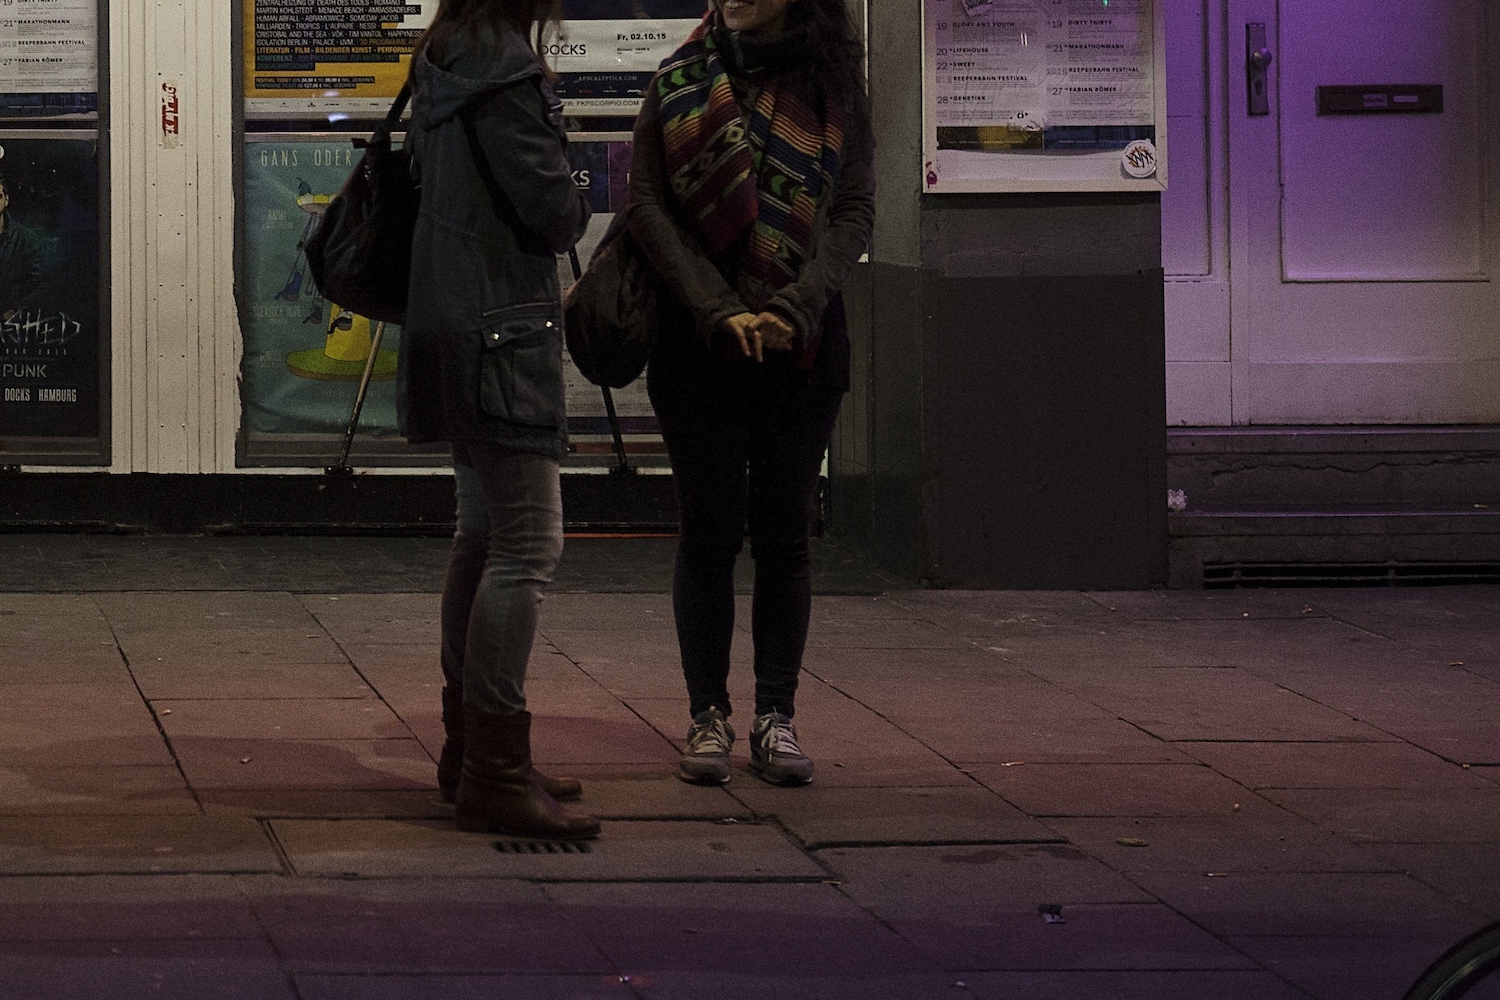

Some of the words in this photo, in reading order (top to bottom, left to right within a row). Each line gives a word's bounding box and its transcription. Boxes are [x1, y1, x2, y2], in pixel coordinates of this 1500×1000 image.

[261, 150, 298, 167] GANS
[314, 149, 352, 167] ODER
[3, 364, 47, 377] PUNK
[5, 388, 30, 401] DOCKS
[38, 389, 77, 402] HAMBURG
